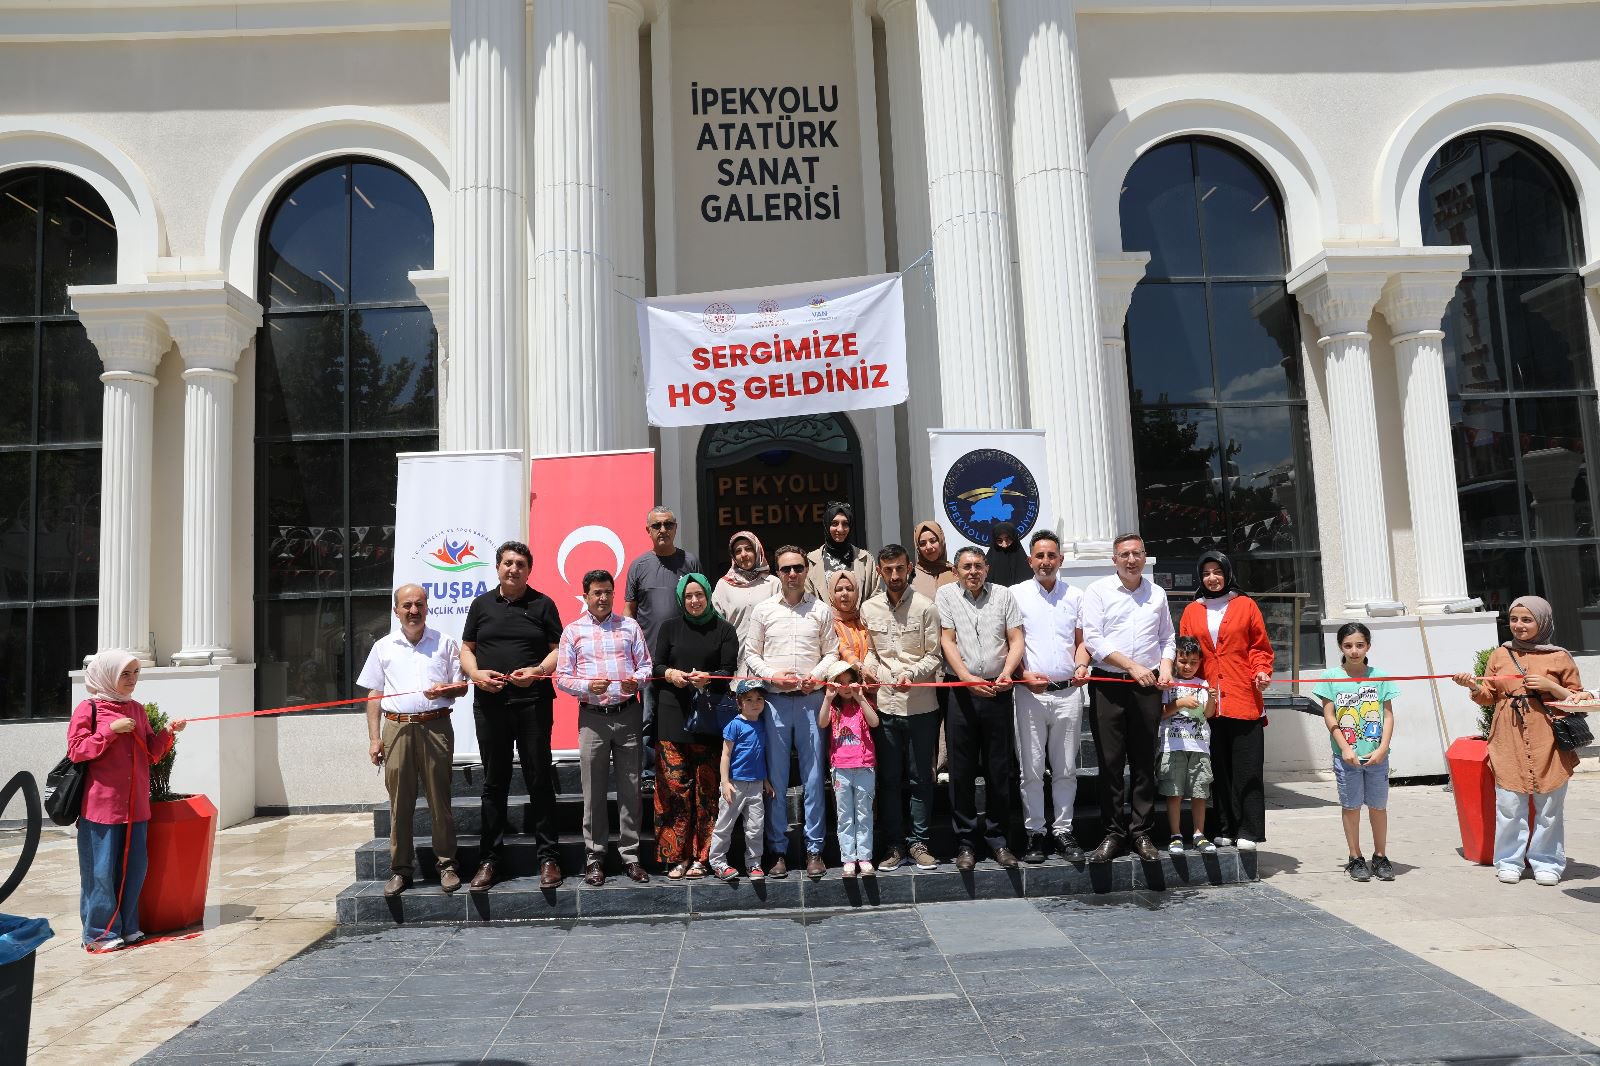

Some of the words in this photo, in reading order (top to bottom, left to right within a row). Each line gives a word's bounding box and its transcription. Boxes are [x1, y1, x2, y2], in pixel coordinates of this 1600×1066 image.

[691, 82, 839, 115] İPEKYOLU
[696, 115, 839, 150] ATATÜRK
[717, 156, 820, 186] SANAT
[701, 184, 840, 222] GALERİSİ
[811, 310, 828, 318] VAN
[691, 329, 859, 371] SERGİMİZE
[667, 379, 737, 411] HOŞ
[743, 359, 890, 402] GELDİNİZ
[718, 472, 838, 496] PEKYOLU
[718, 498, 825, 526] ELEDİYE
[1016, 500, 1036, 533] DİYESİ
[421, 581, 488, 603] TUŞBA
[427, 605, 454, 617] NÇLİK
[456, 606, 469, 615] ME
